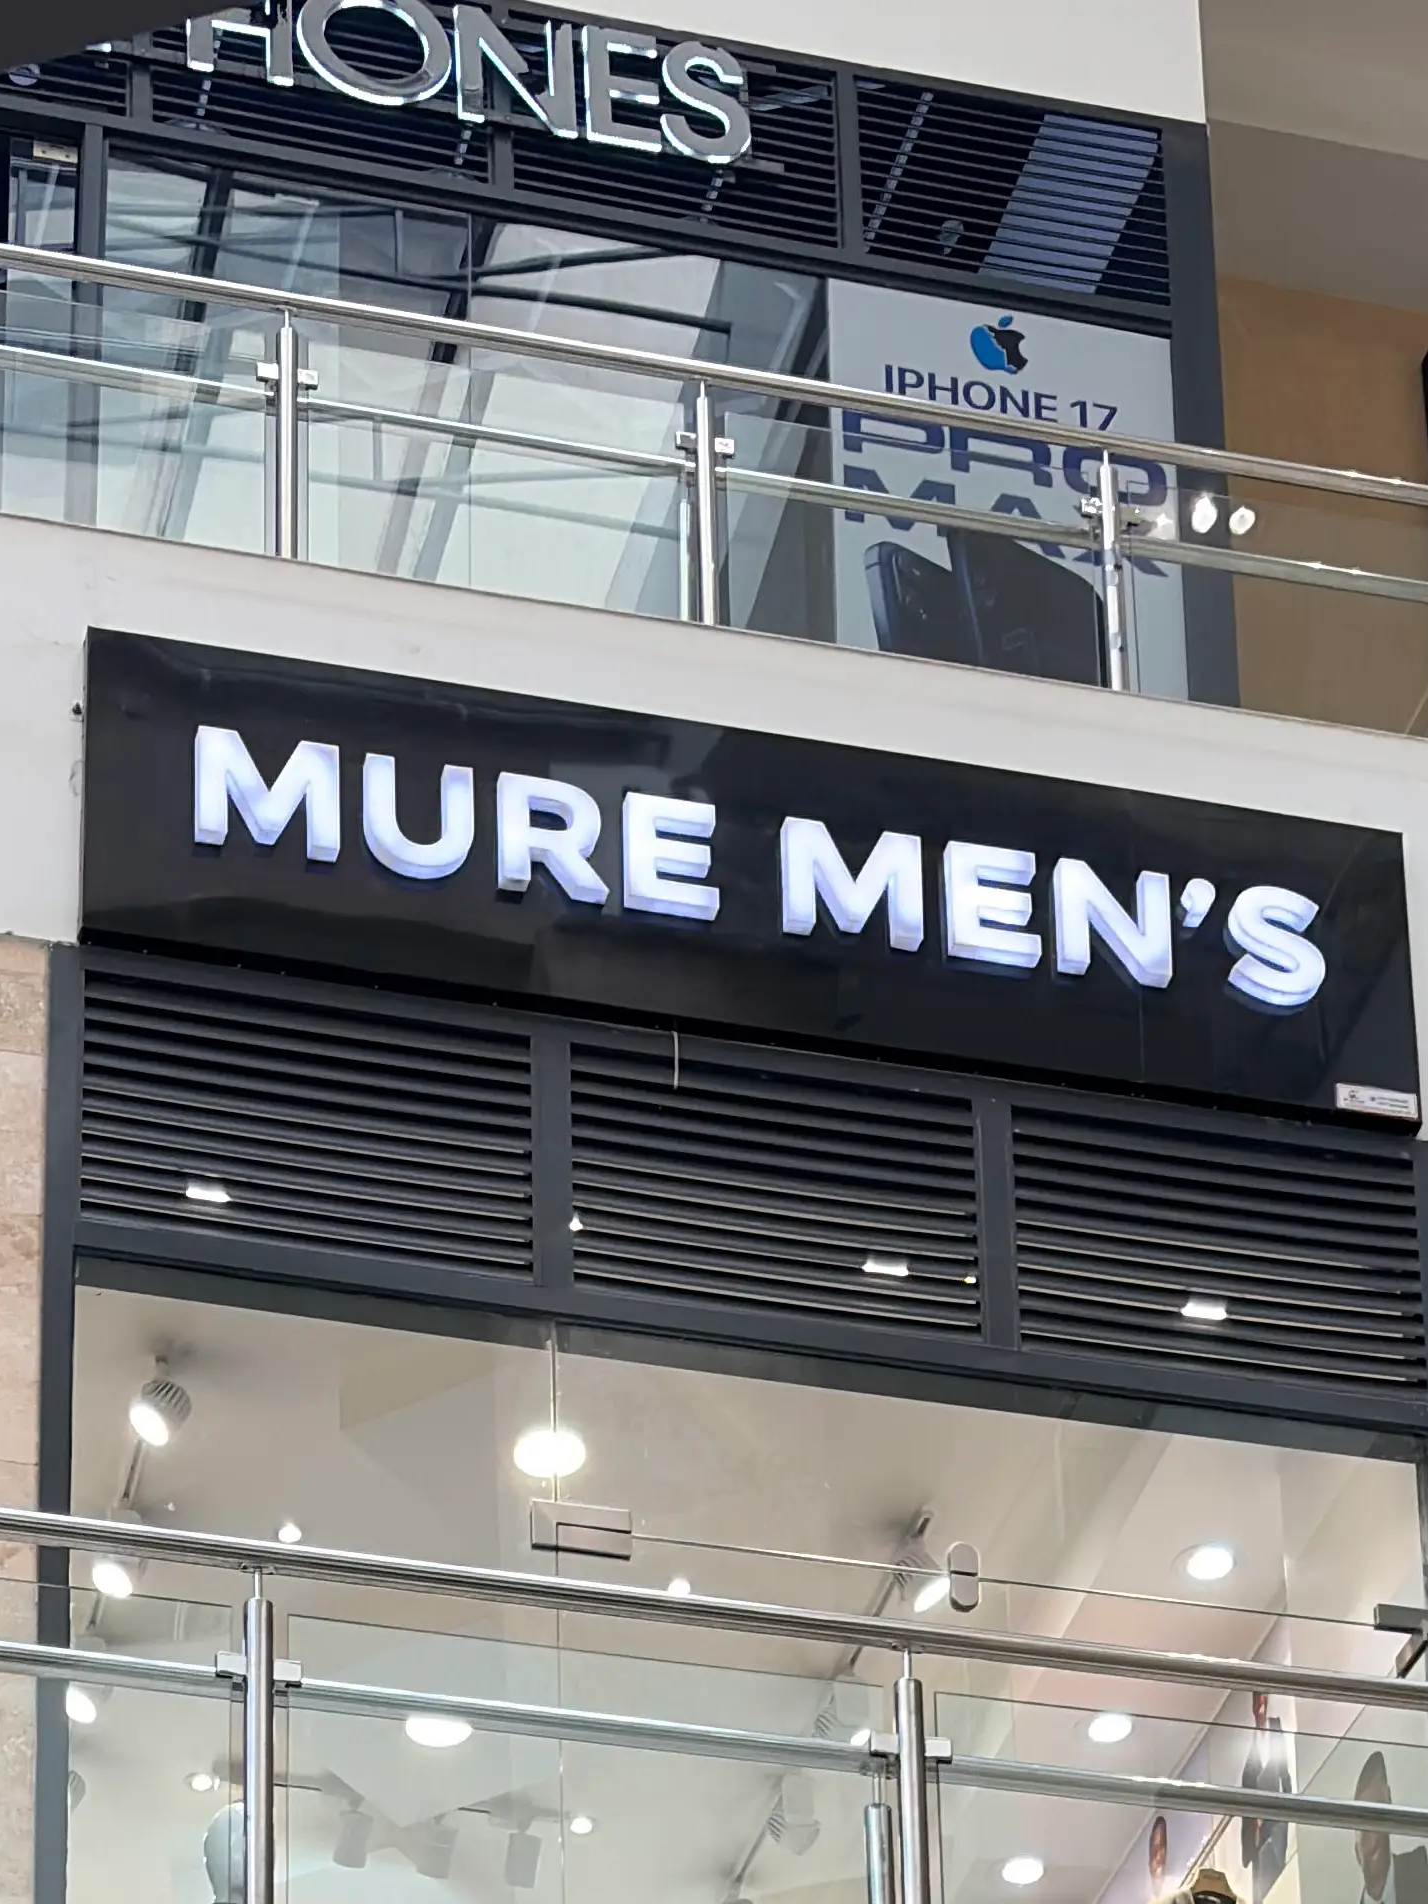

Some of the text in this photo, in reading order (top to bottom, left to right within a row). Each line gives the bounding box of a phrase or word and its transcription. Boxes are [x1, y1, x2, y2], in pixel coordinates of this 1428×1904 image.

[85, 0, 752, 163] HONES
[884, 364, 1118, 432] IPHONE 17
[194, 724, 1326, 1006] MURE MEN'S
